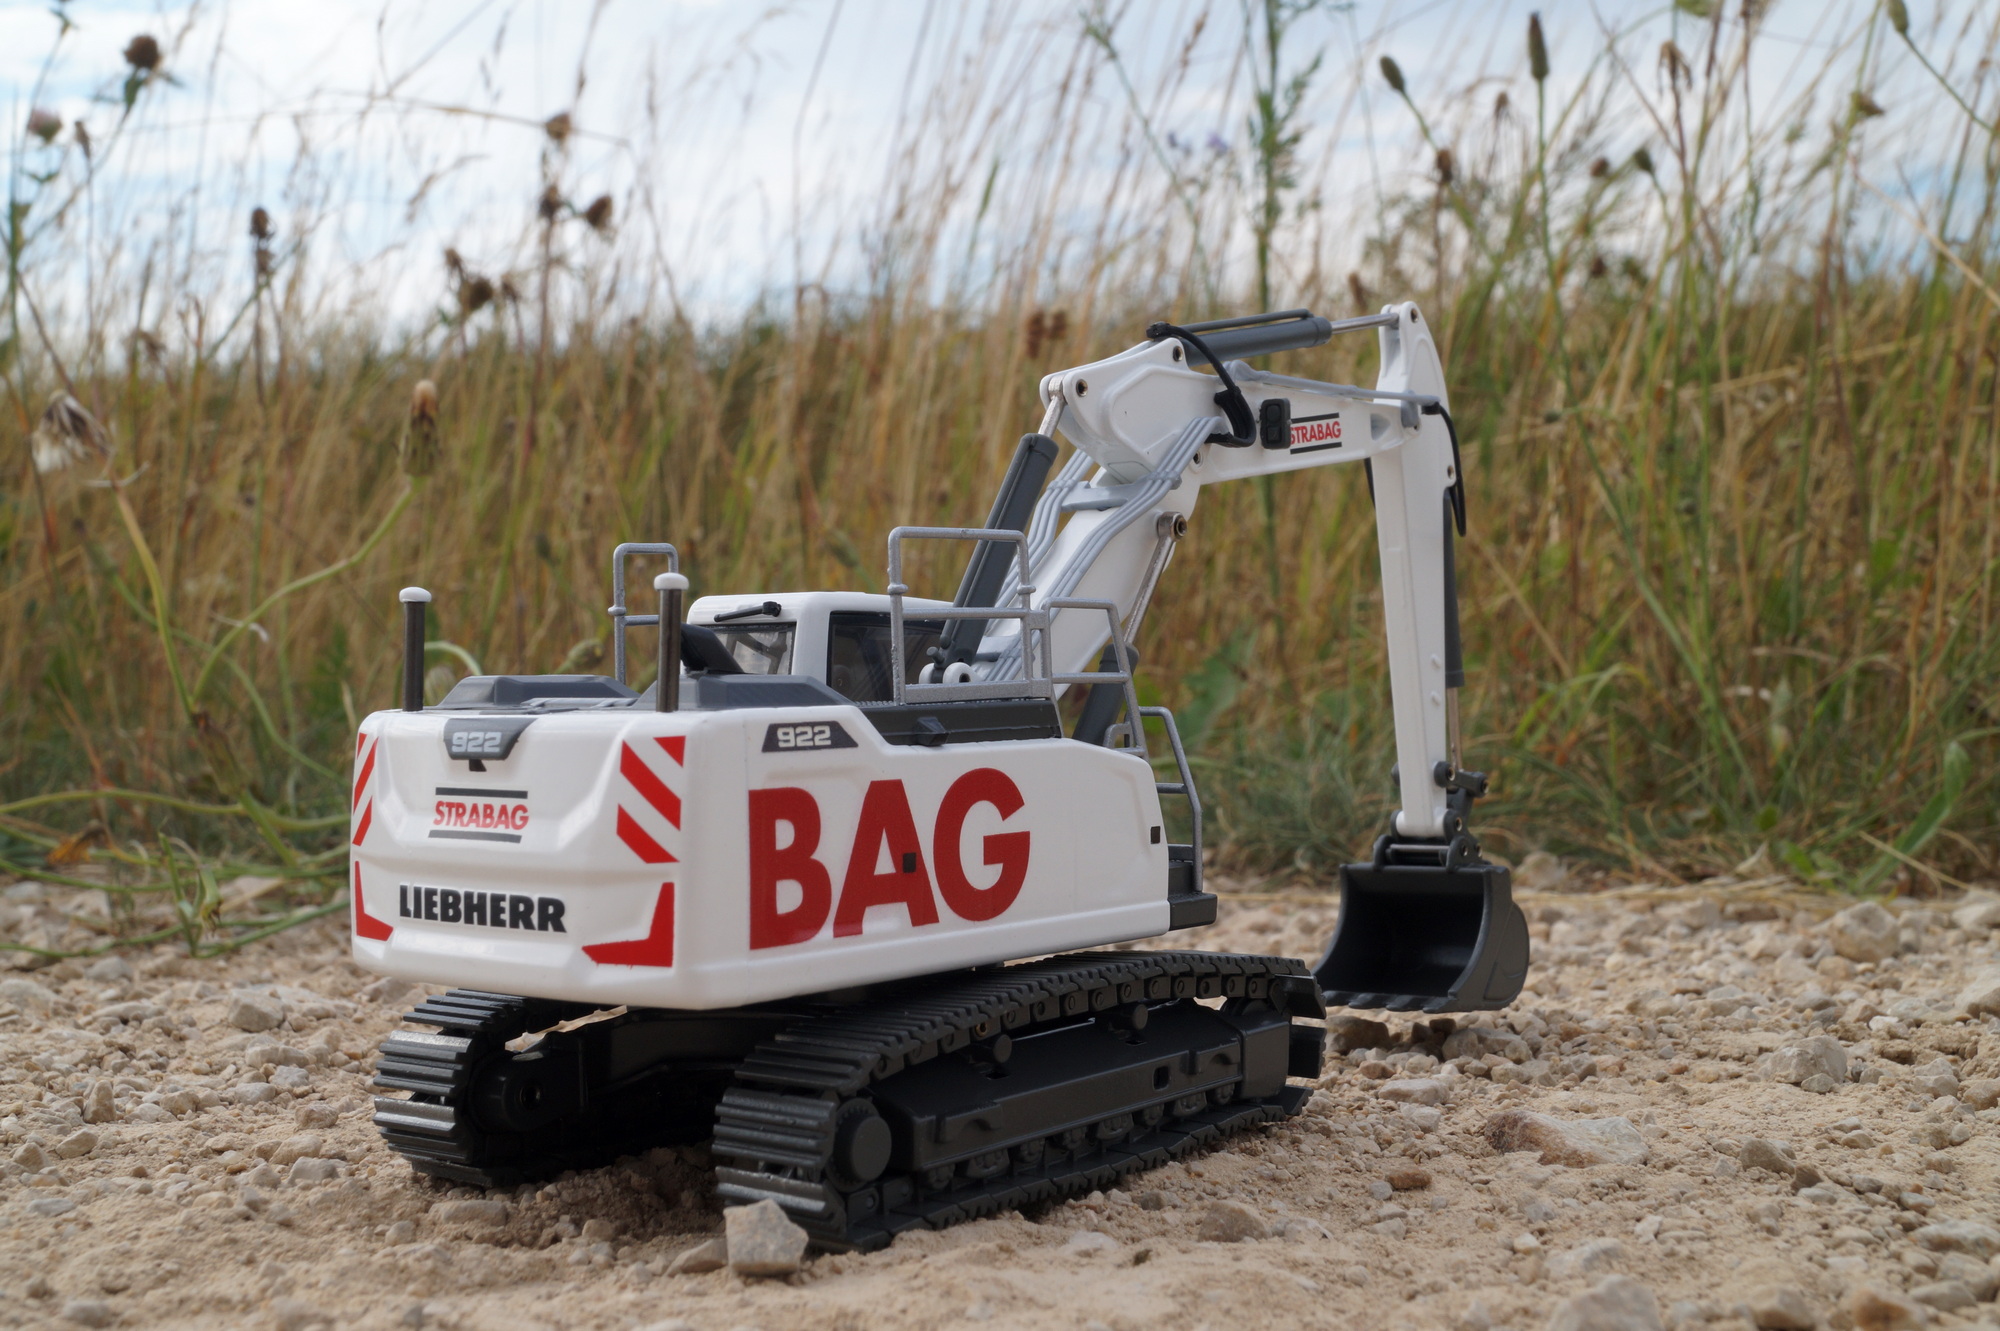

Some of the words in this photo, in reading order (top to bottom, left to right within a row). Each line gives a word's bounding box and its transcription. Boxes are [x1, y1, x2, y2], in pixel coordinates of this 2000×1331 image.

[451, 731, 502, 752] 922
[776, 725, 832, 748] 922
[433, 801, 529, 830] STRABAG
[748, 767, 1031, 951] BAG
[399, 884, 567, 933] LIEBHERR
